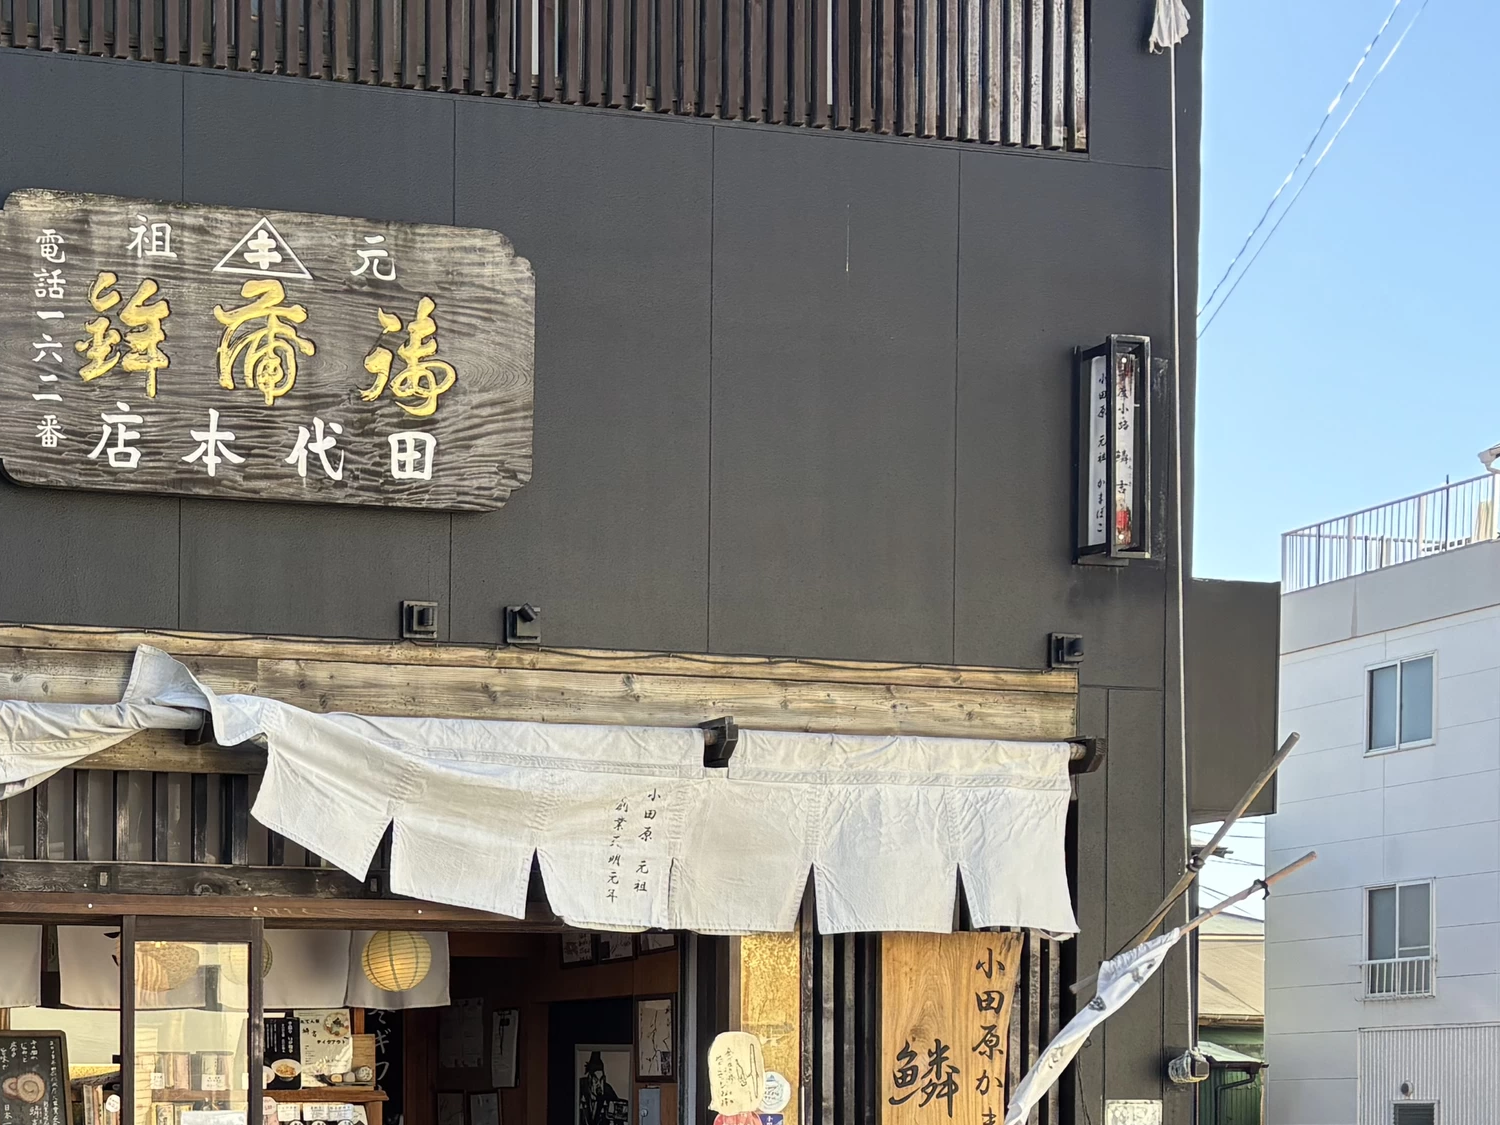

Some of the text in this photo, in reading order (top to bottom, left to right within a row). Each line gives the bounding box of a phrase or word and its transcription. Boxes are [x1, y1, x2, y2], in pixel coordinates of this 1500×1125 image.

[31, 229, 67, 448] 電話一六二番
[87, 400, 438, 481] 田代本店
[634, 788, 661, 892] 小田原 元祖
